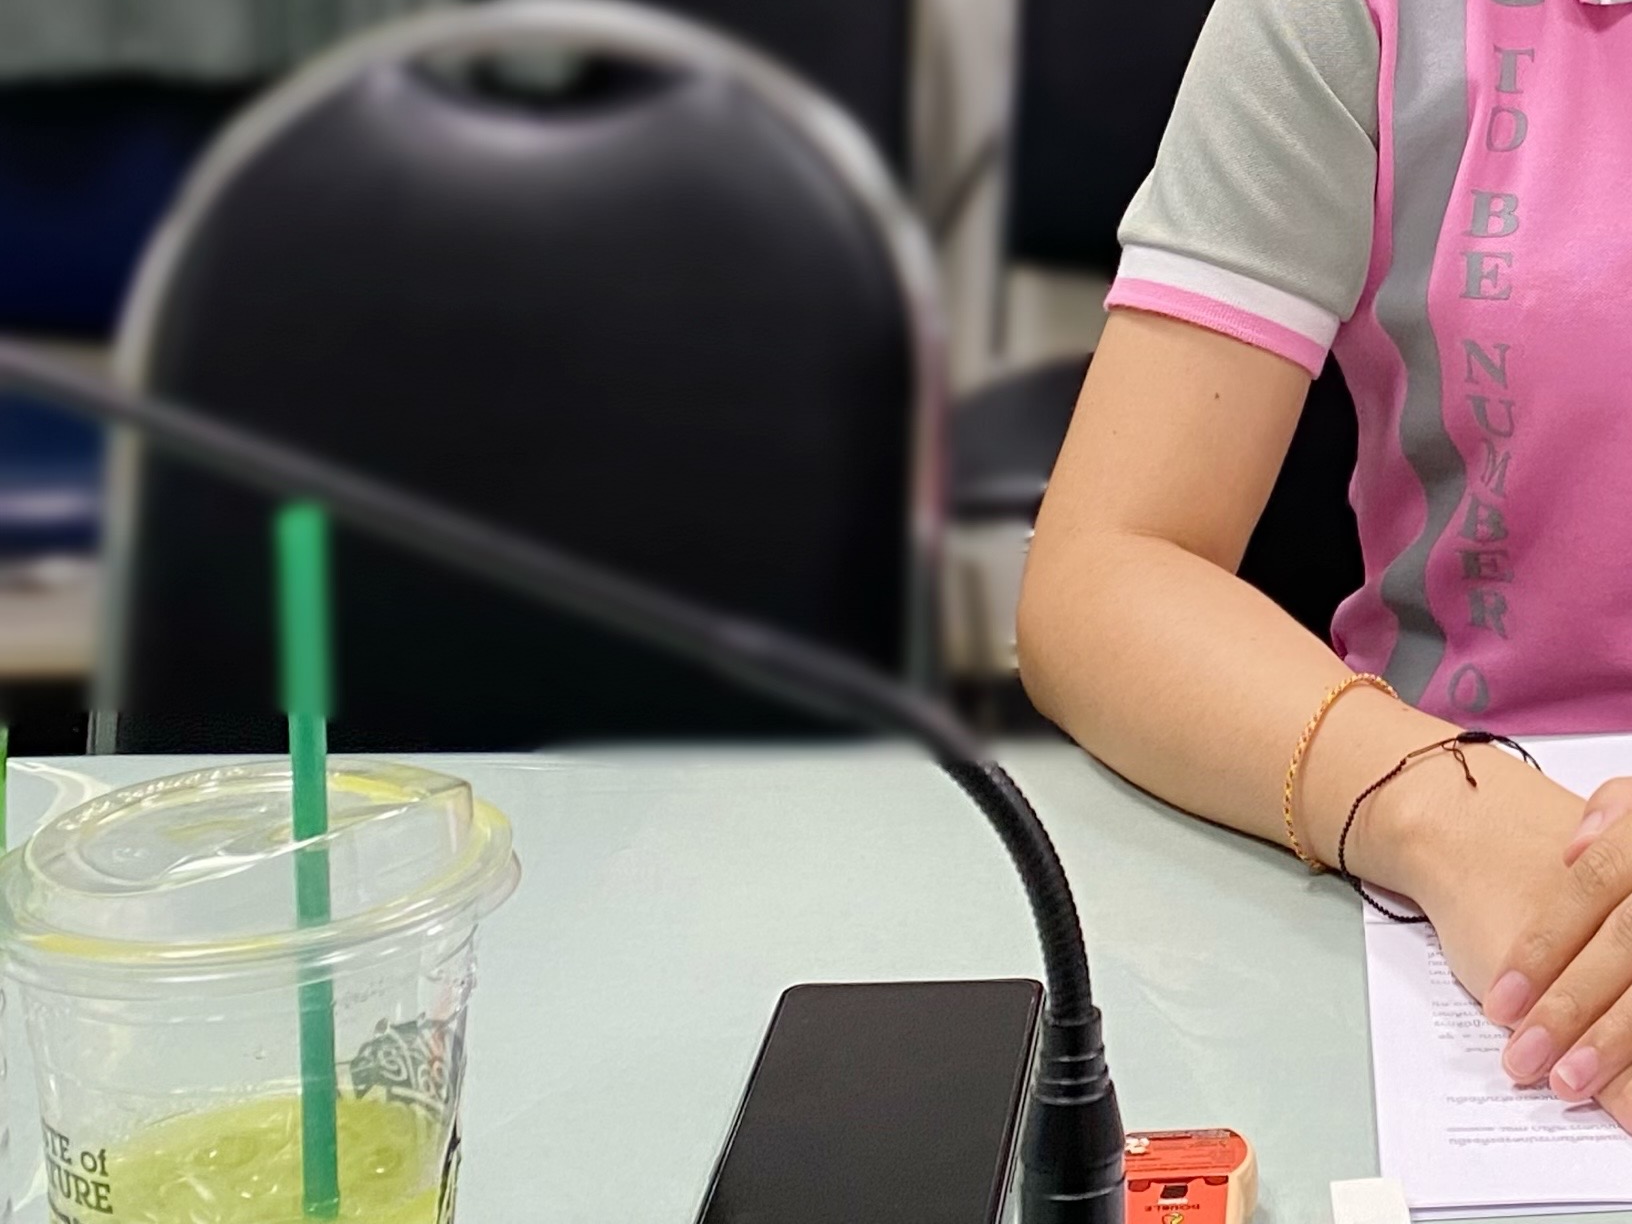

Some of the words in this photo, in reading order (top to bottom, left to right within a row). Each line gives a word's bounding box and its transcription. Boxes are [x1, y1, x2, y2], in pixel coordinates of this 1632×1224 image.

[1485, 46, 1535, 154] TO
[1458, 189, 1520, 301] BE
[1457, 338, 1517, 640] NUMBER
[1447, 662, 1491, 718] O
[80, 1148, 109, 1177] of
